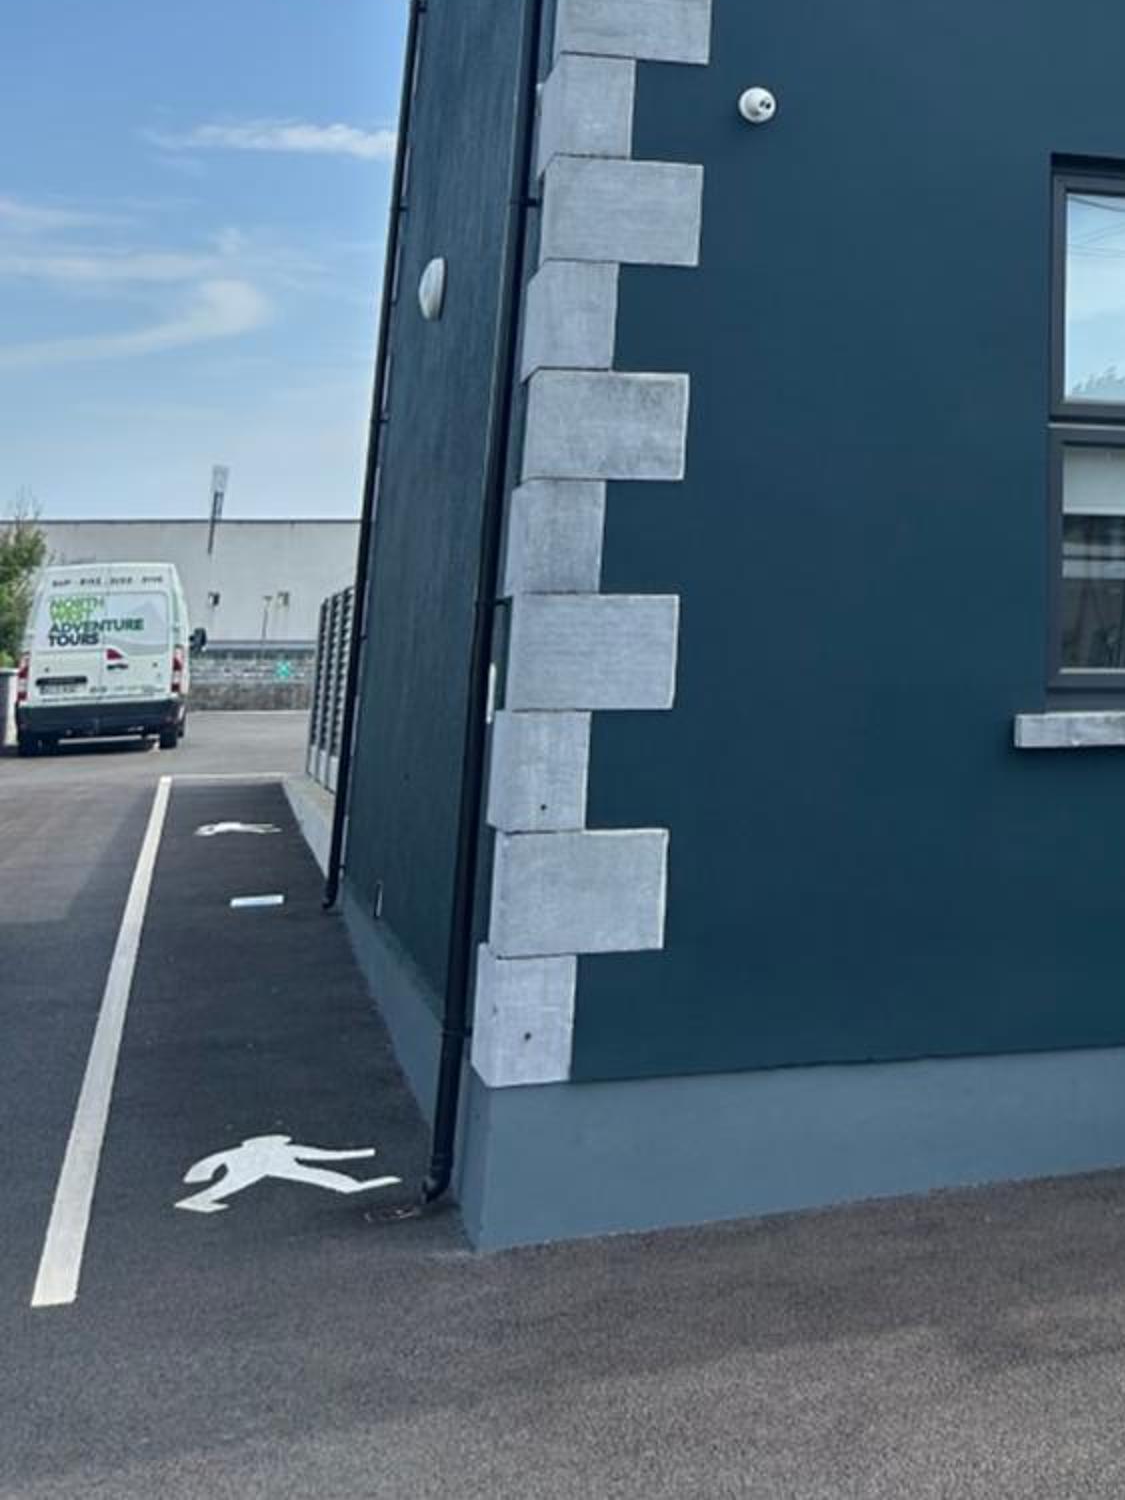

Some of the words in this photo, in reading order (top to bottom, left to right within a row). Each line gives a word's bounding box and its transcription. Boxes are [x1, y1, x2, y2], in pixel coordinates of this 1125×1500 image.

[51, 597, 104, 611] NORTH
[49, 618, 144, 633] ADVENTURE
[48, 632, 99, 647] TOURS
